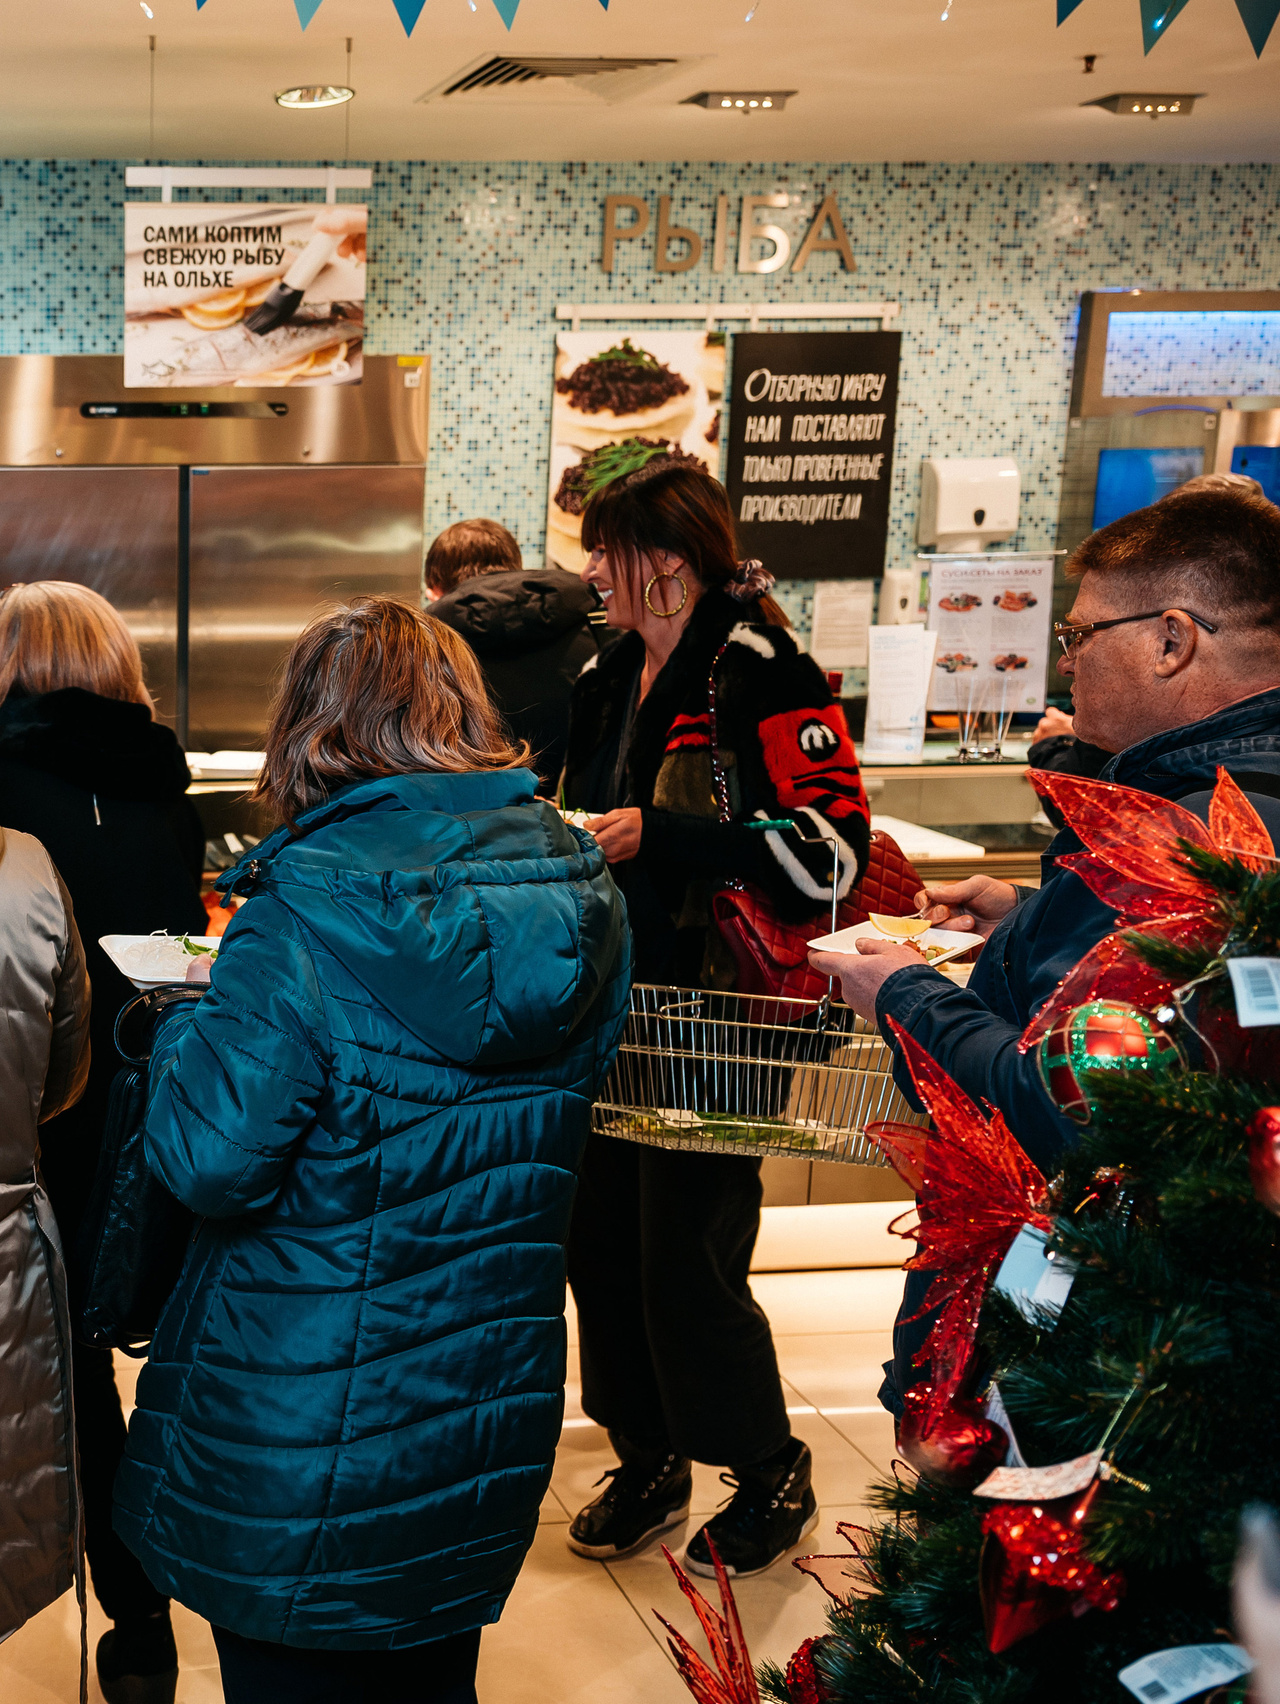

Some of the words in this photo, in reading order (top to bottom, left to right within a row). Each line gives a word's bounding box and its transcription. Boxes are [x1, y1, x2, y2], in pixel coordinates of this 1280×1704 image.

[143, 226, 198, 243] САМИ
[205, 226, 282, 243] КОПТИМ
[601, 191, 858, 274] РЫБА
[143, 248, 226, 265] СВЕЖУЮ
[233, 248, 285, 265] РЫБУ
[144, 271, 168, 288] НА
[174, 271, 234, 288] ОЛЬХЕ
